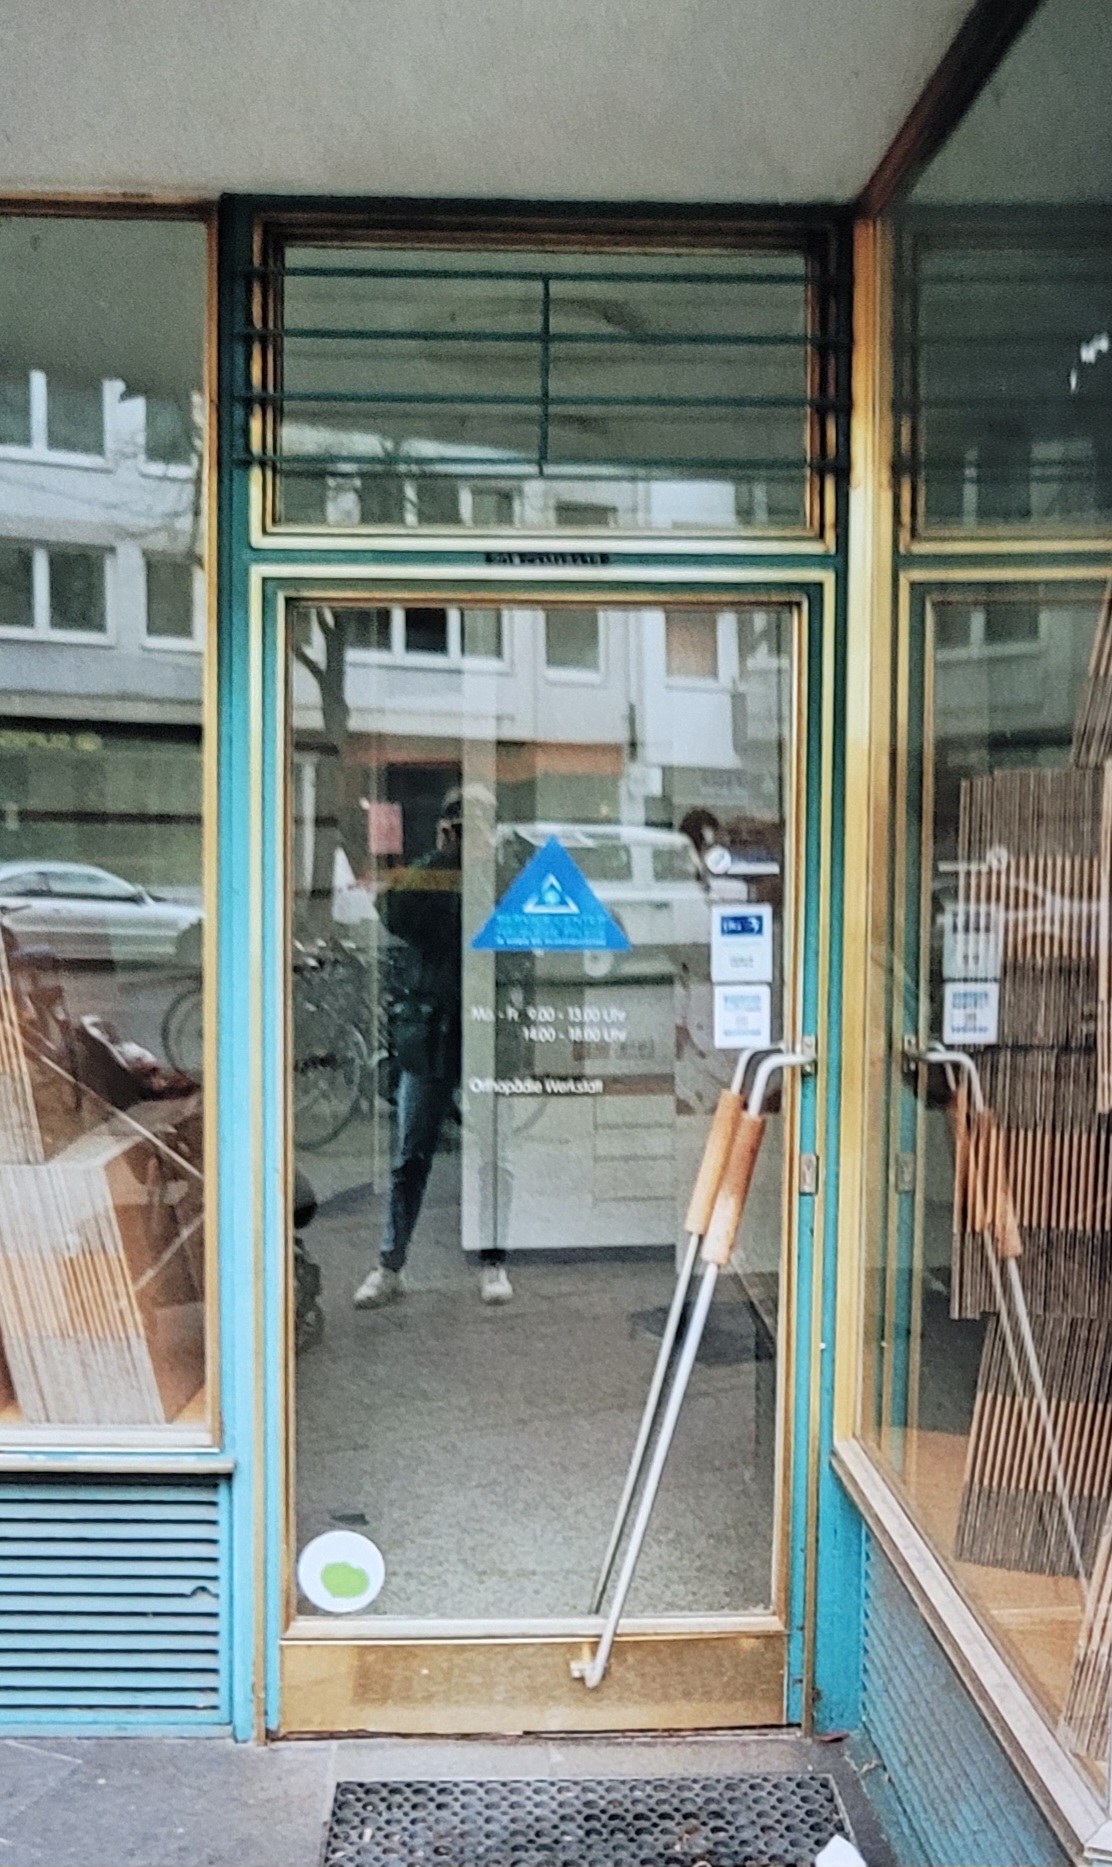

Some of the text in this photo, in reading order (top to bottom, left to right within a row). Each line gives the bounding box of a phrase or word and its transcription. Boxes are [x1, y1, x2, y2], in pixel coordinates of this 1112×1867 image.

[471, 1006, 495, 1021] Mo
[602, 1006, 627, 1022] Uhr
[602, 1026, 628, 1042] Uhr
[468, 1076, 604, 1095] Orthopädie Werkstatt
